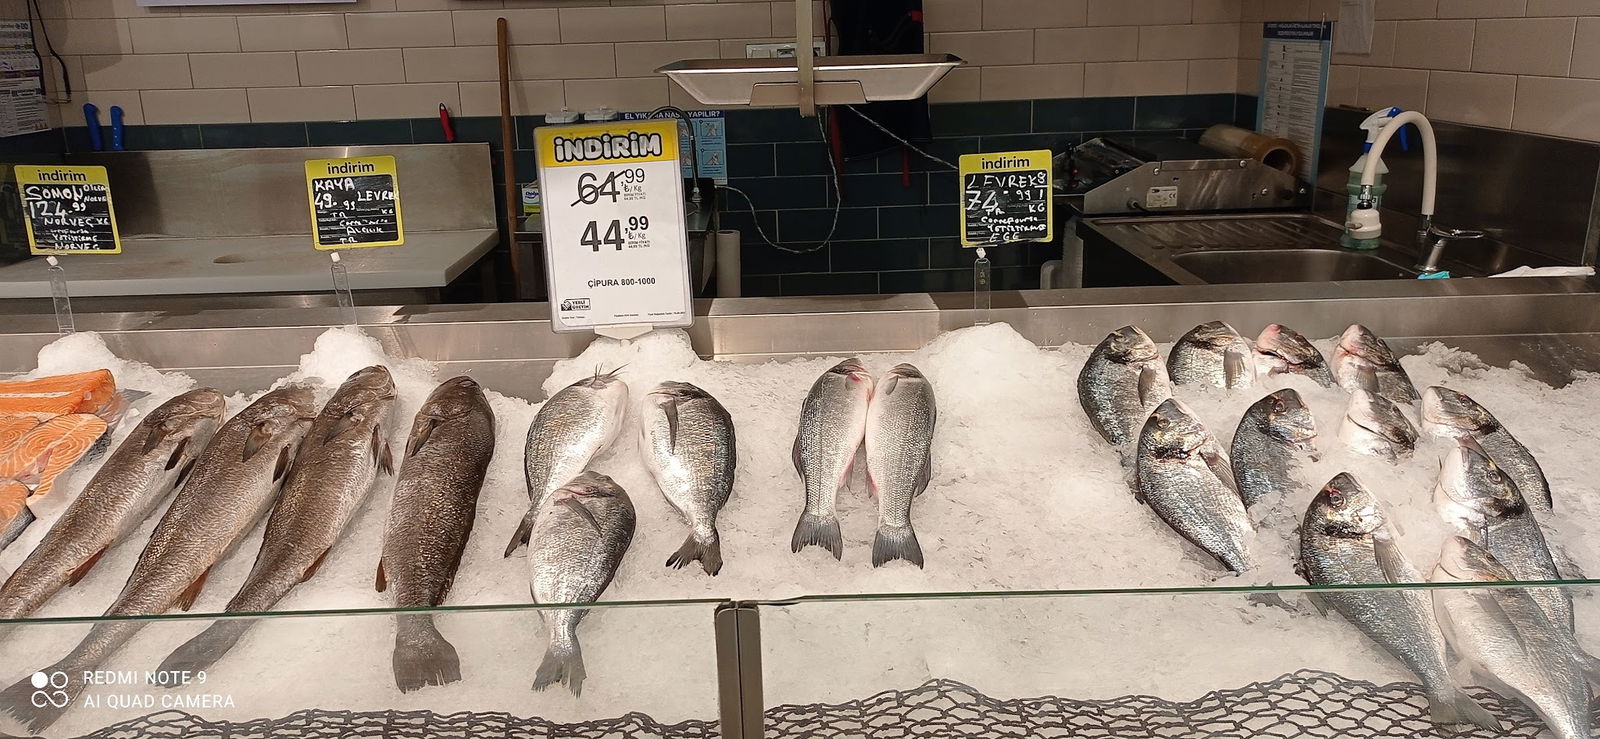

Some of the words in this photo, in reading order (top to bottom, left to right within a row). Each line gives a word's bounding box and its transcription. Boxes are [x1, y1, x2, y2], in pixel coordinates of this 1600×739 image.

[688, 110, 720, 118] YAPILIR?
[328, 161, 374, 174] indirim
[982, 156, 1030, 170] indirim
[38, 170, 86, 181] indirim
[966, 174, 1038, 189] LEVREK
[314, 178, 355, 192] KAYA
[24, 185, 84, 202] SOMON
[1028, 203, 1044, 212] KG
[588, 278, 620, 288] ÇİPURA
[621, 278, 656, 286] 800-1000
